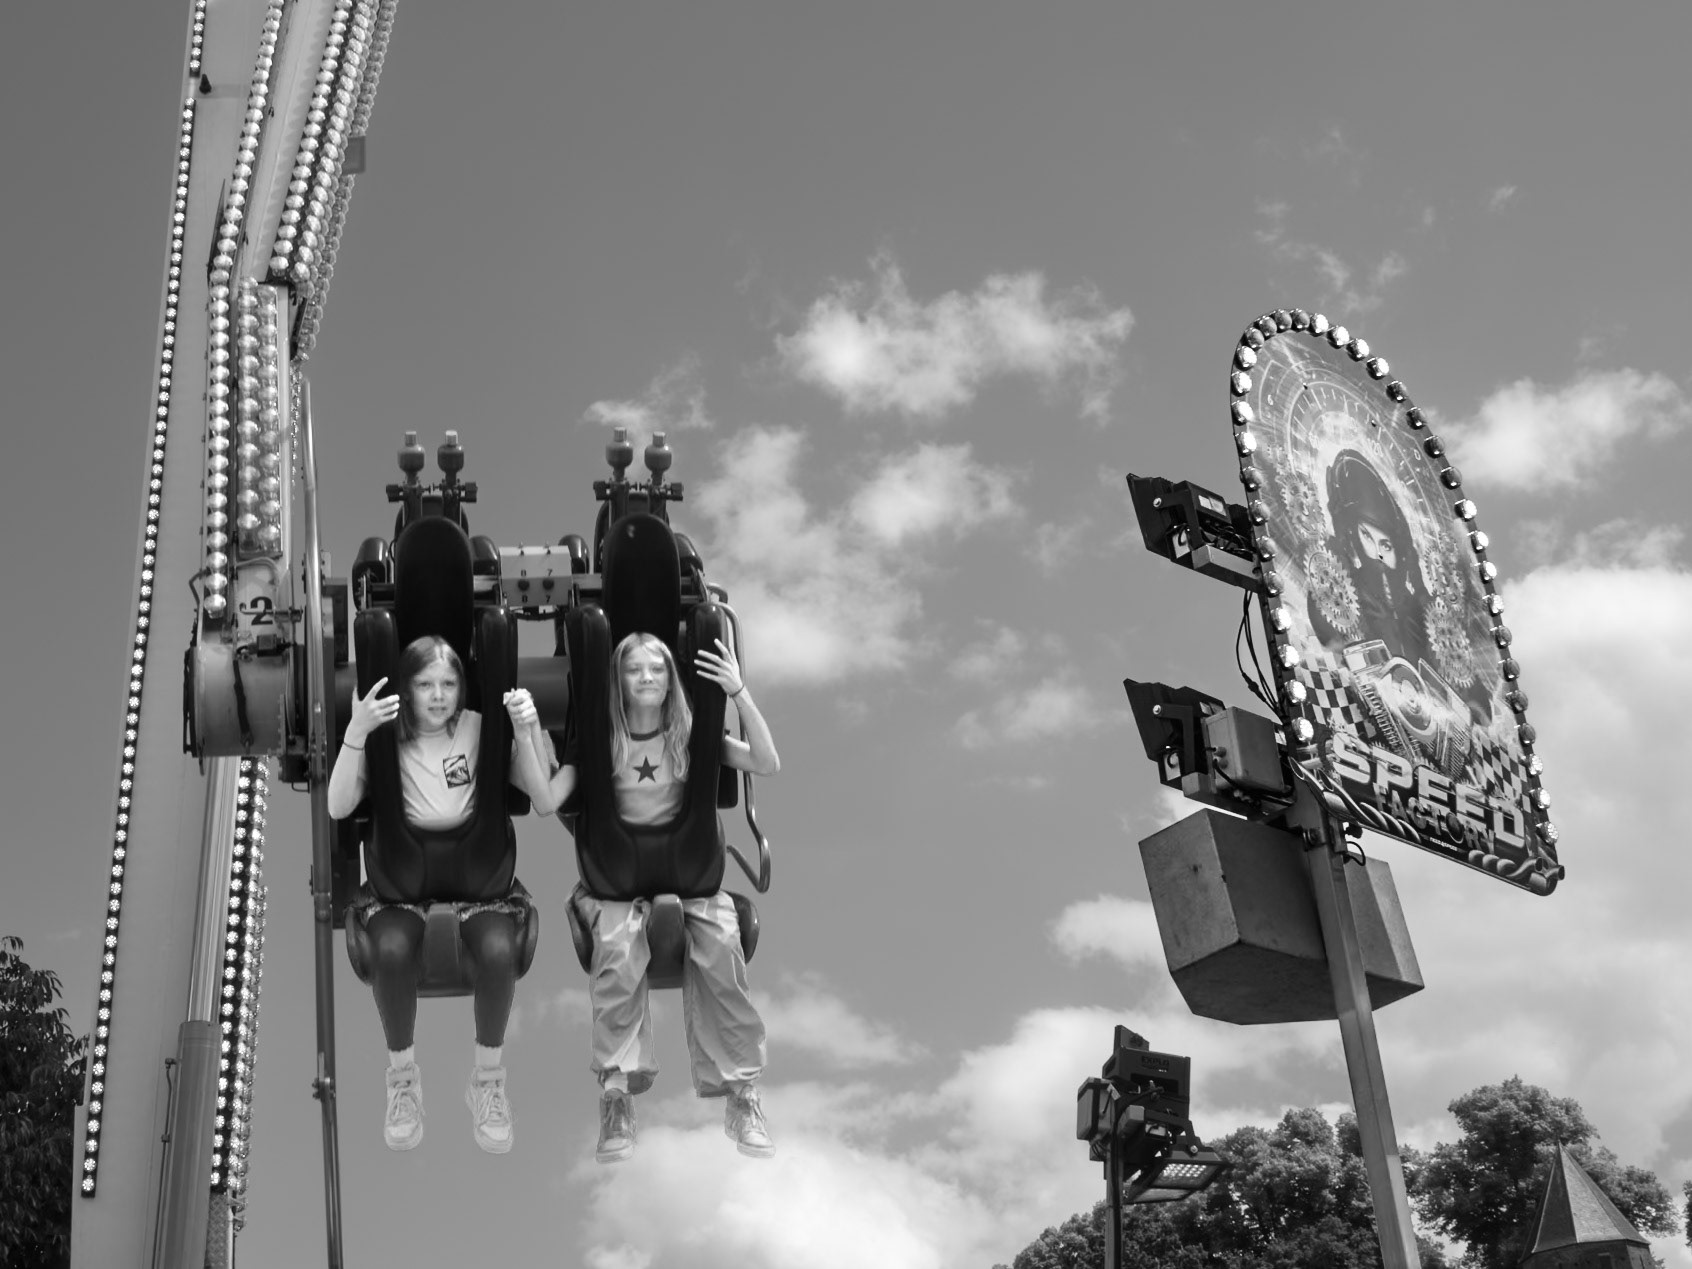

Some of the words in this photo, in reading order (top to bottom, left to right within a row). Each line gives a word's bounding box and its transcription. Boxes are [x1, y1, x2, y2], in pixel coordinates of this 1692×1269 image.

[250, 596, 274, 626] 2
[1332, 731, 1525, 848] SPEED
[1372, 782, 1495, 855] FACTORY
